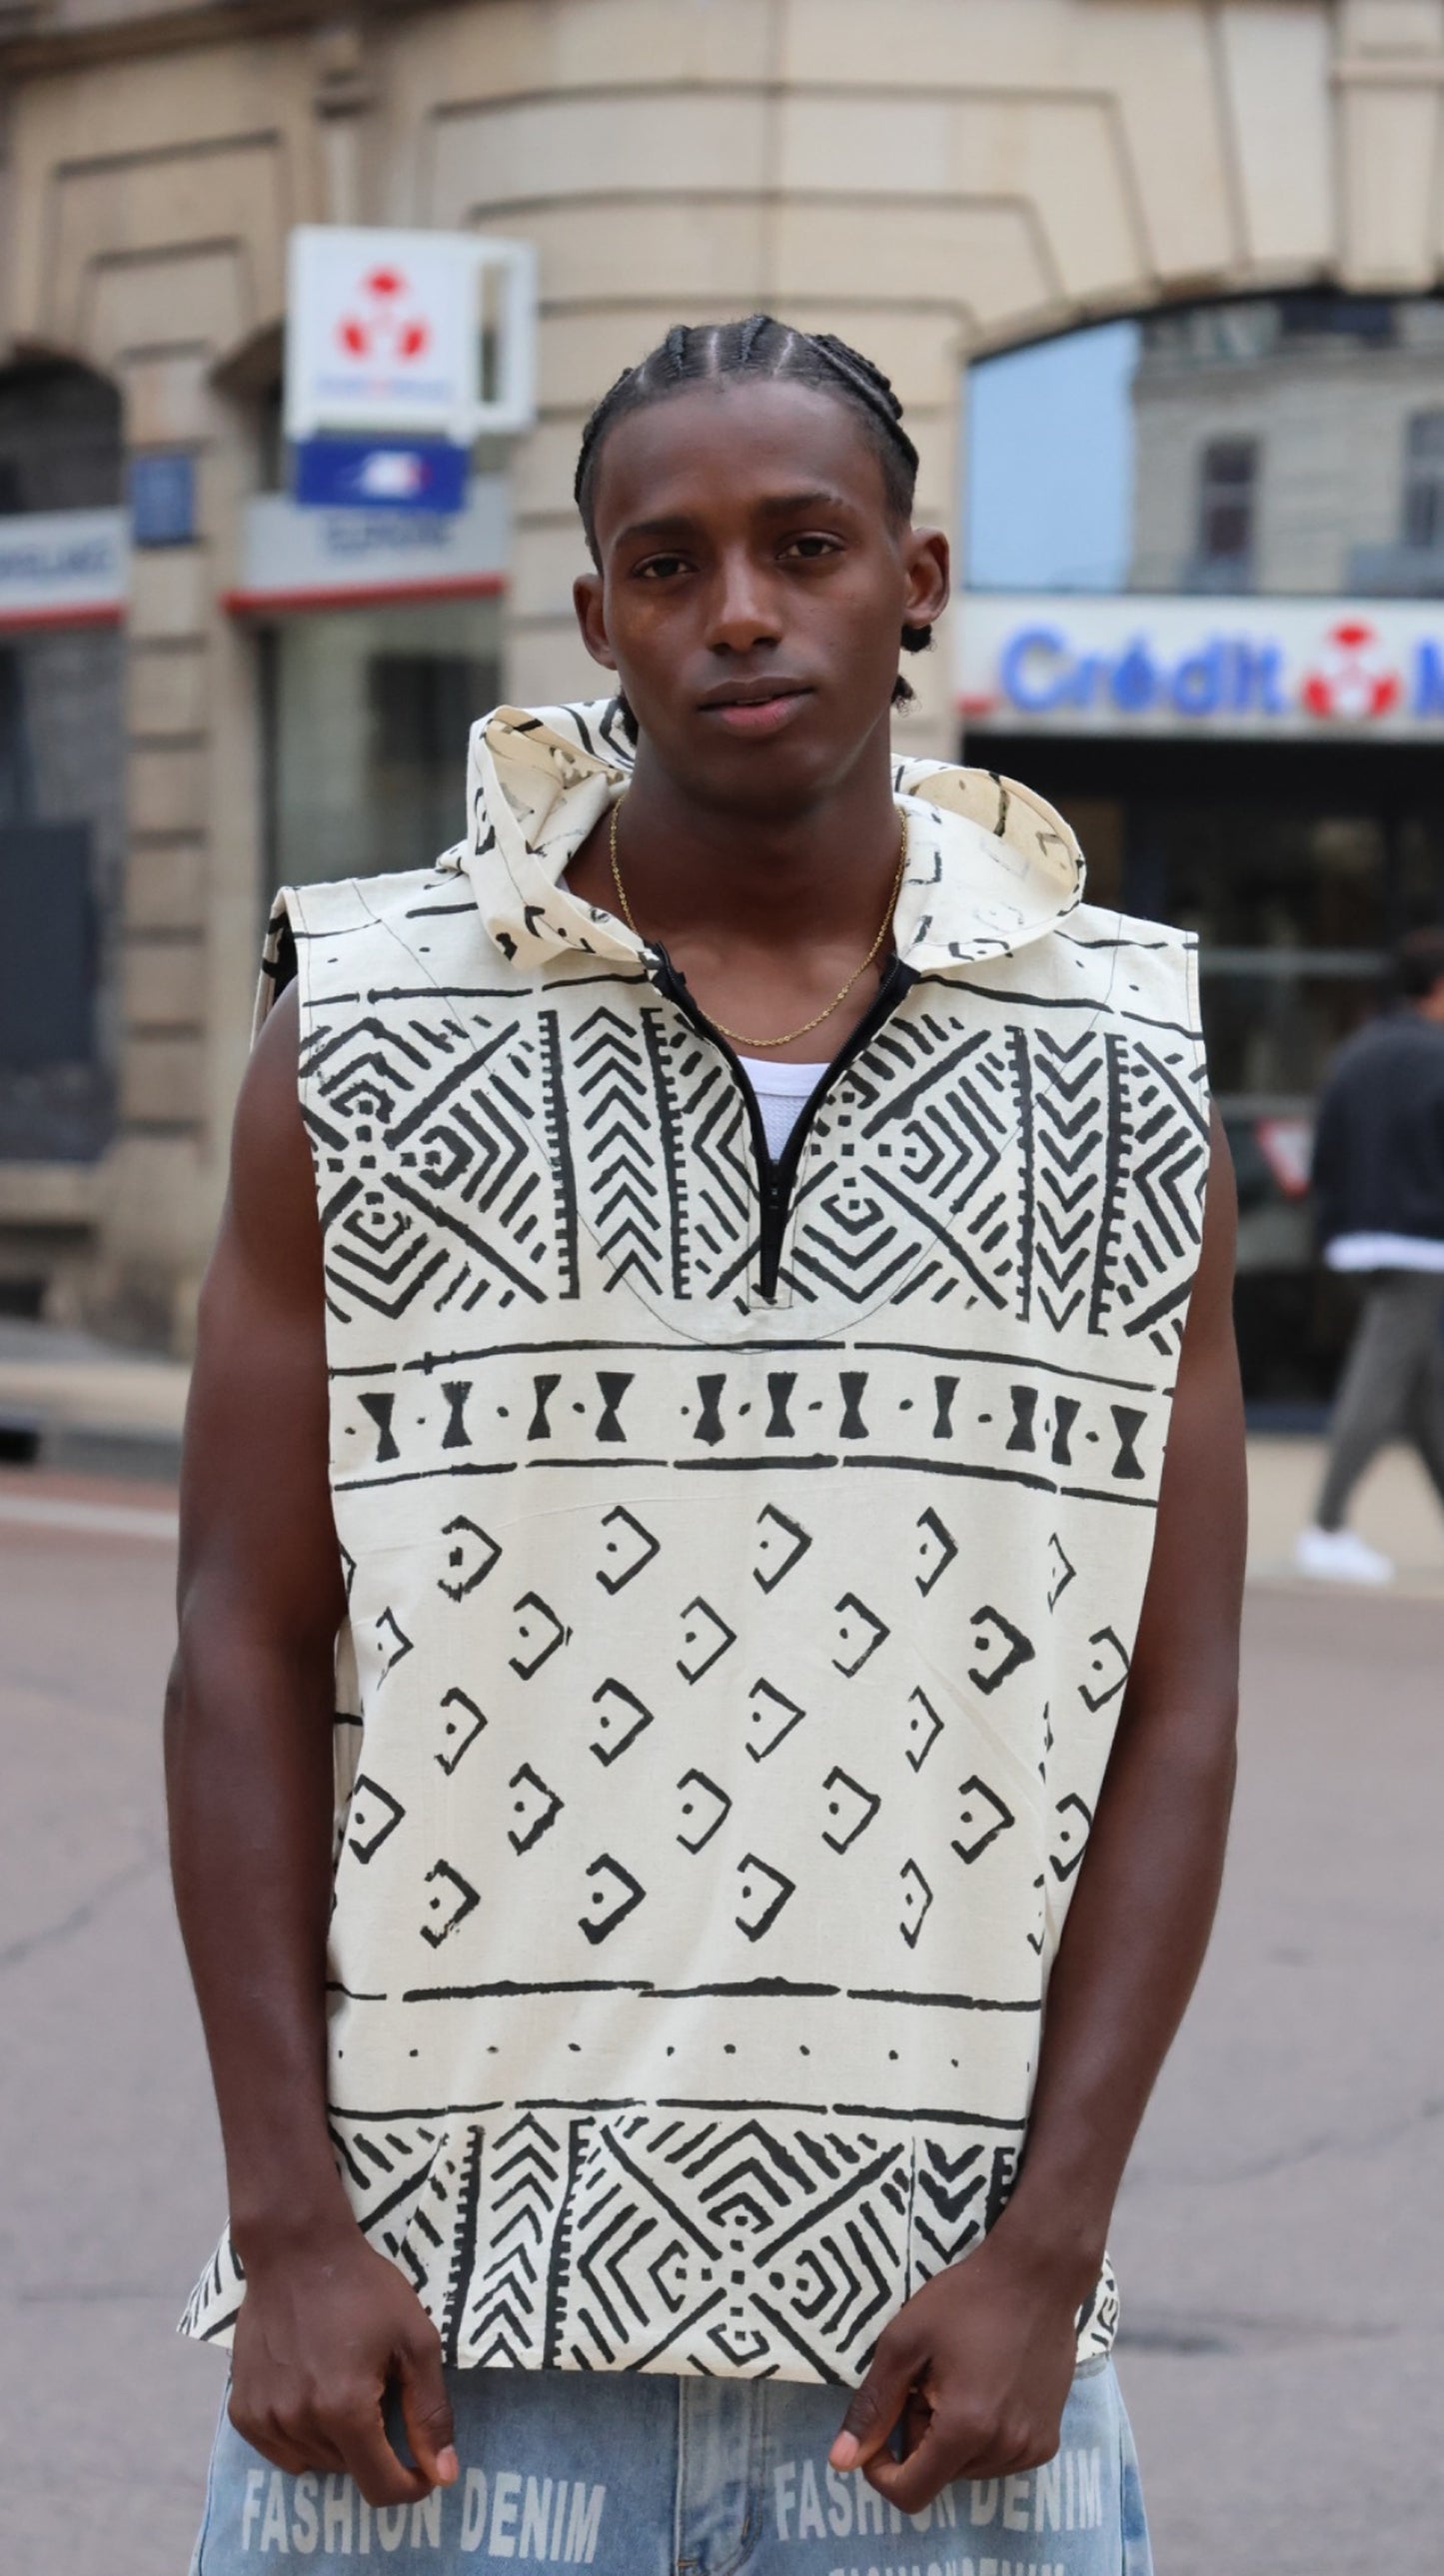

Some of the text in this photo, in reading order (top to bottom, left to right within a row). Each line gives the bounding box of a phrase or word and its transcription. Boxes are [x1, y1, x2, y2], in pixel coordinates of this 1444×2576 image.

[1000, 624, 1286, 715] Crédit
[460, 2467, 606, 2563] DENIM
[773, 2447, 1101, 2541] FASHN DENIM
